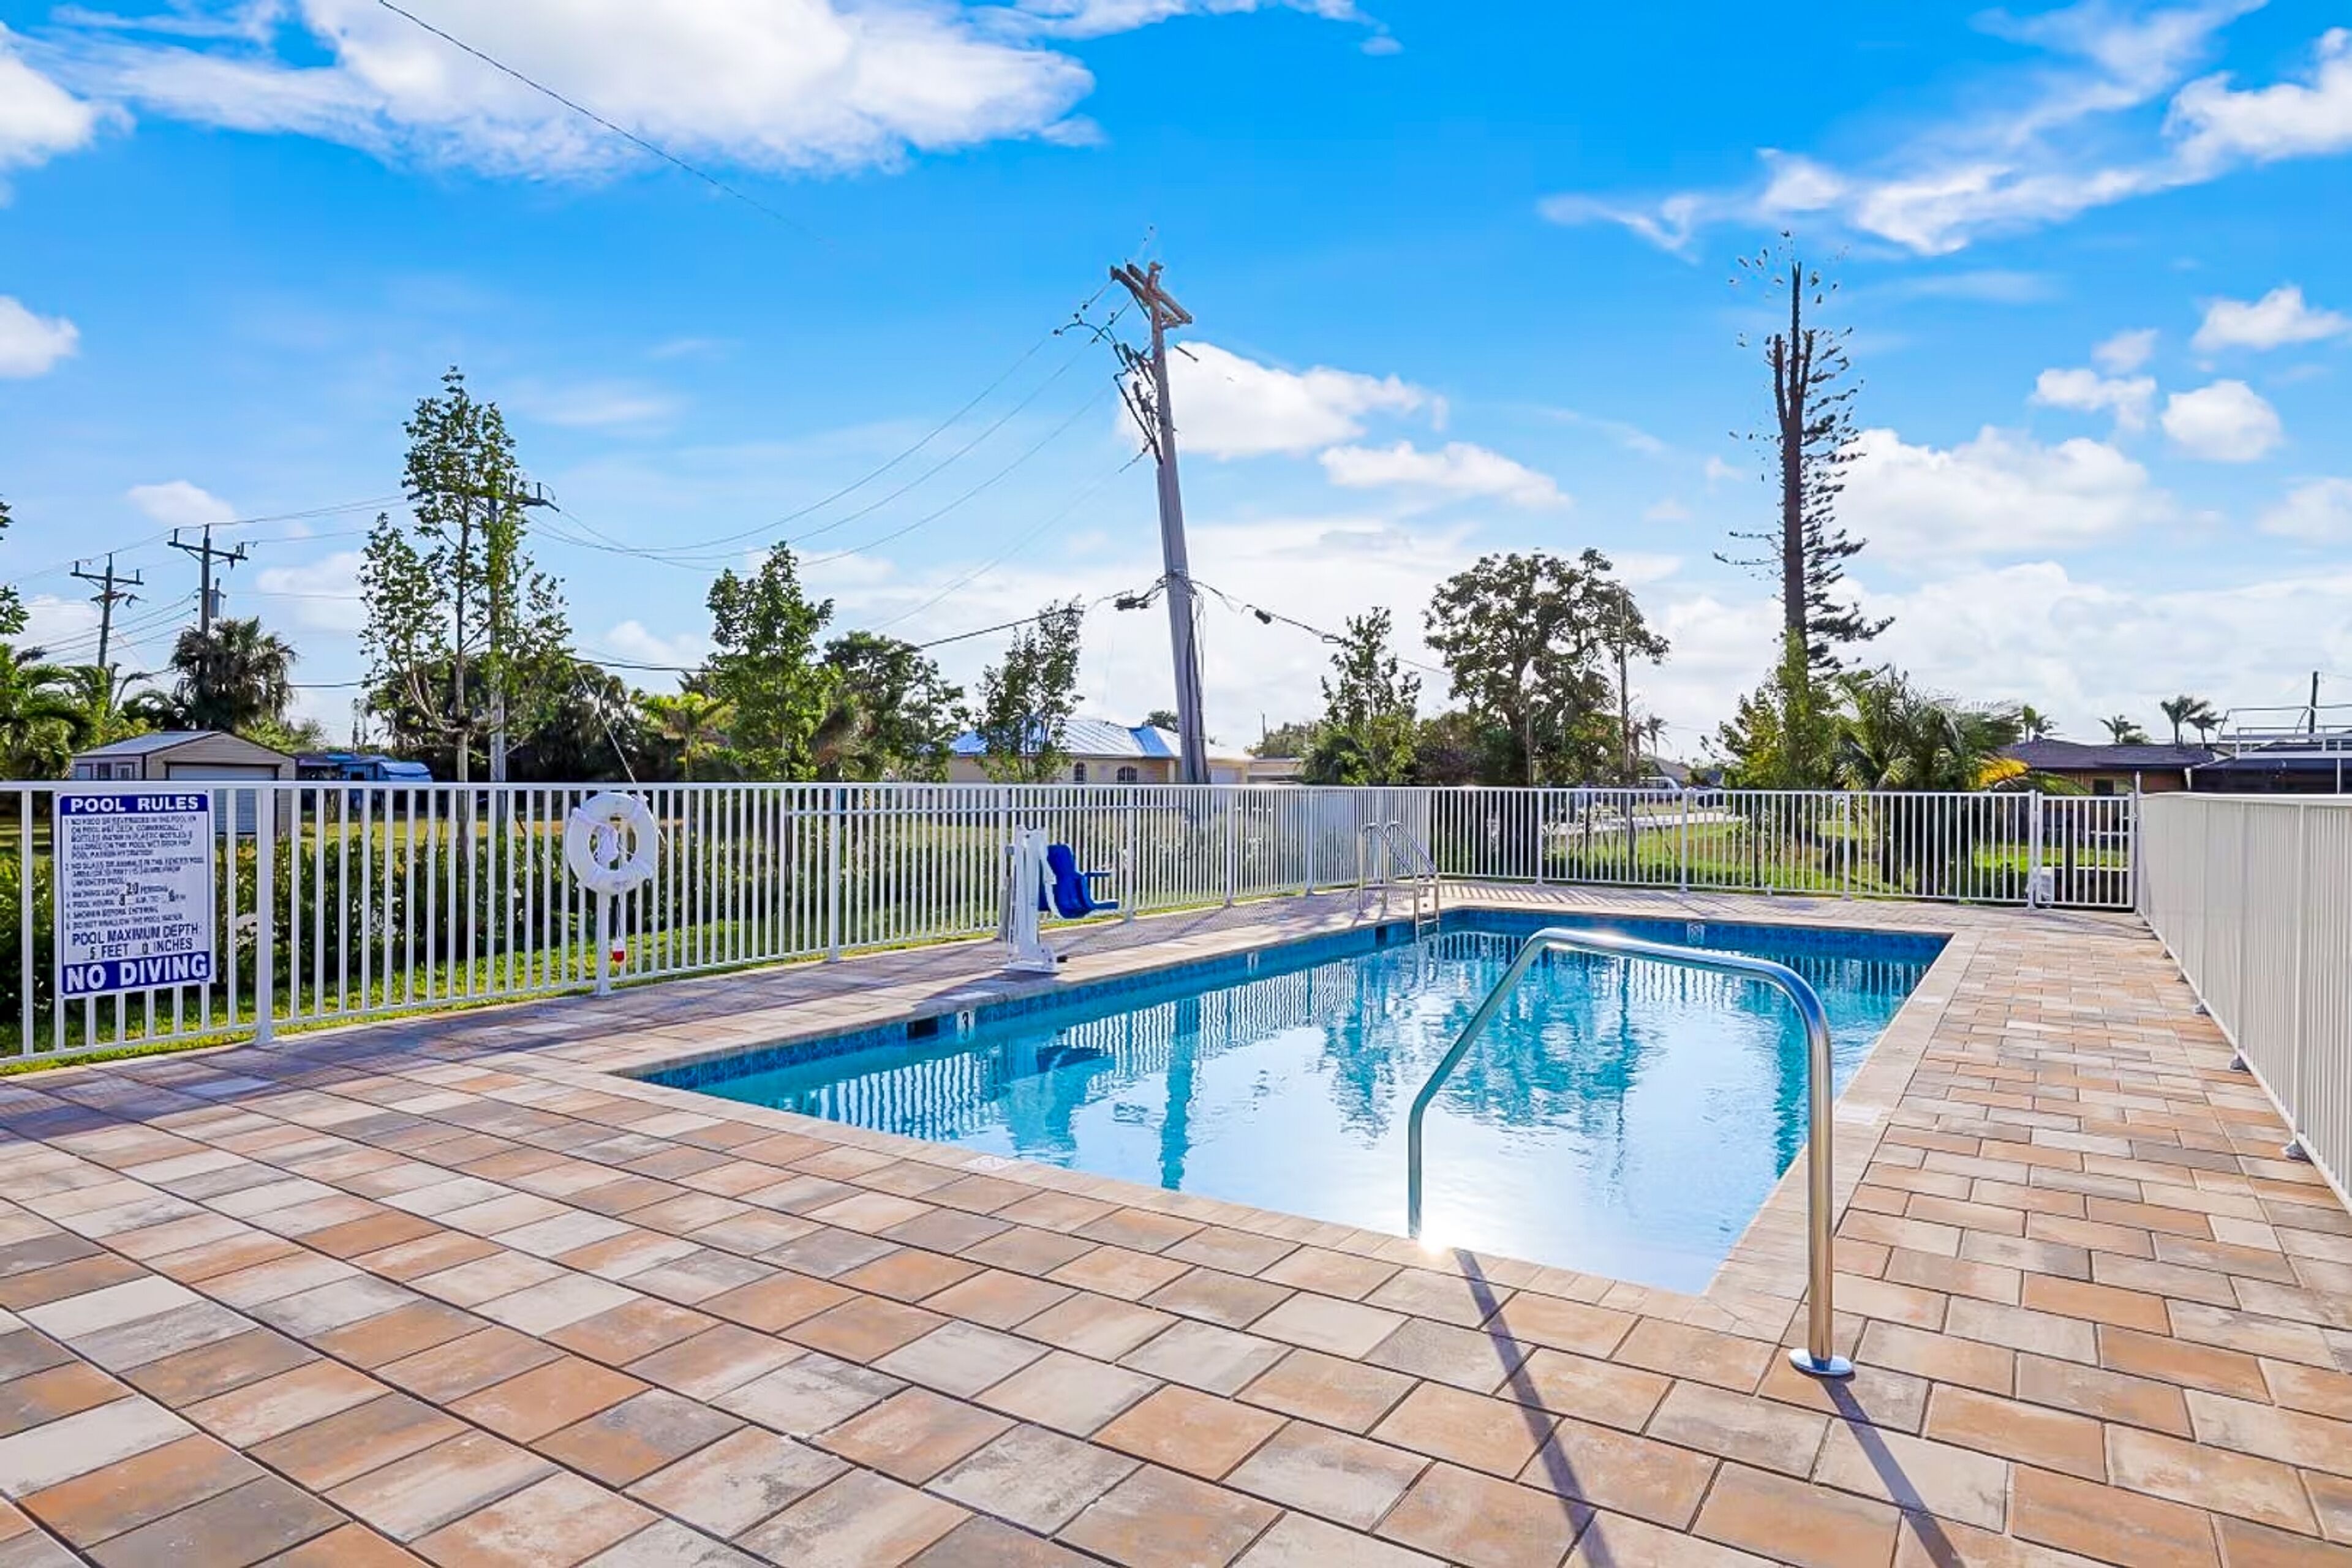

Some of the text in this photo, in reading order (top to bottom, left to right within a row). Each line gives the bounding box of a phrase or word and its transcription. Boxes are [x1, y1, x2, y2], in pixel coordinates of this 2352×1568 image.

[70, 796, 198, 813] POOL RULES
[72, 932, 105, 946] POOL
[107, 926, 160, 943] MAXIMUM
[102, 943, 129, 957] FEET
[154, 938, 193, 952] INCHES
[66, 954, 208, 992] NO DIVING
